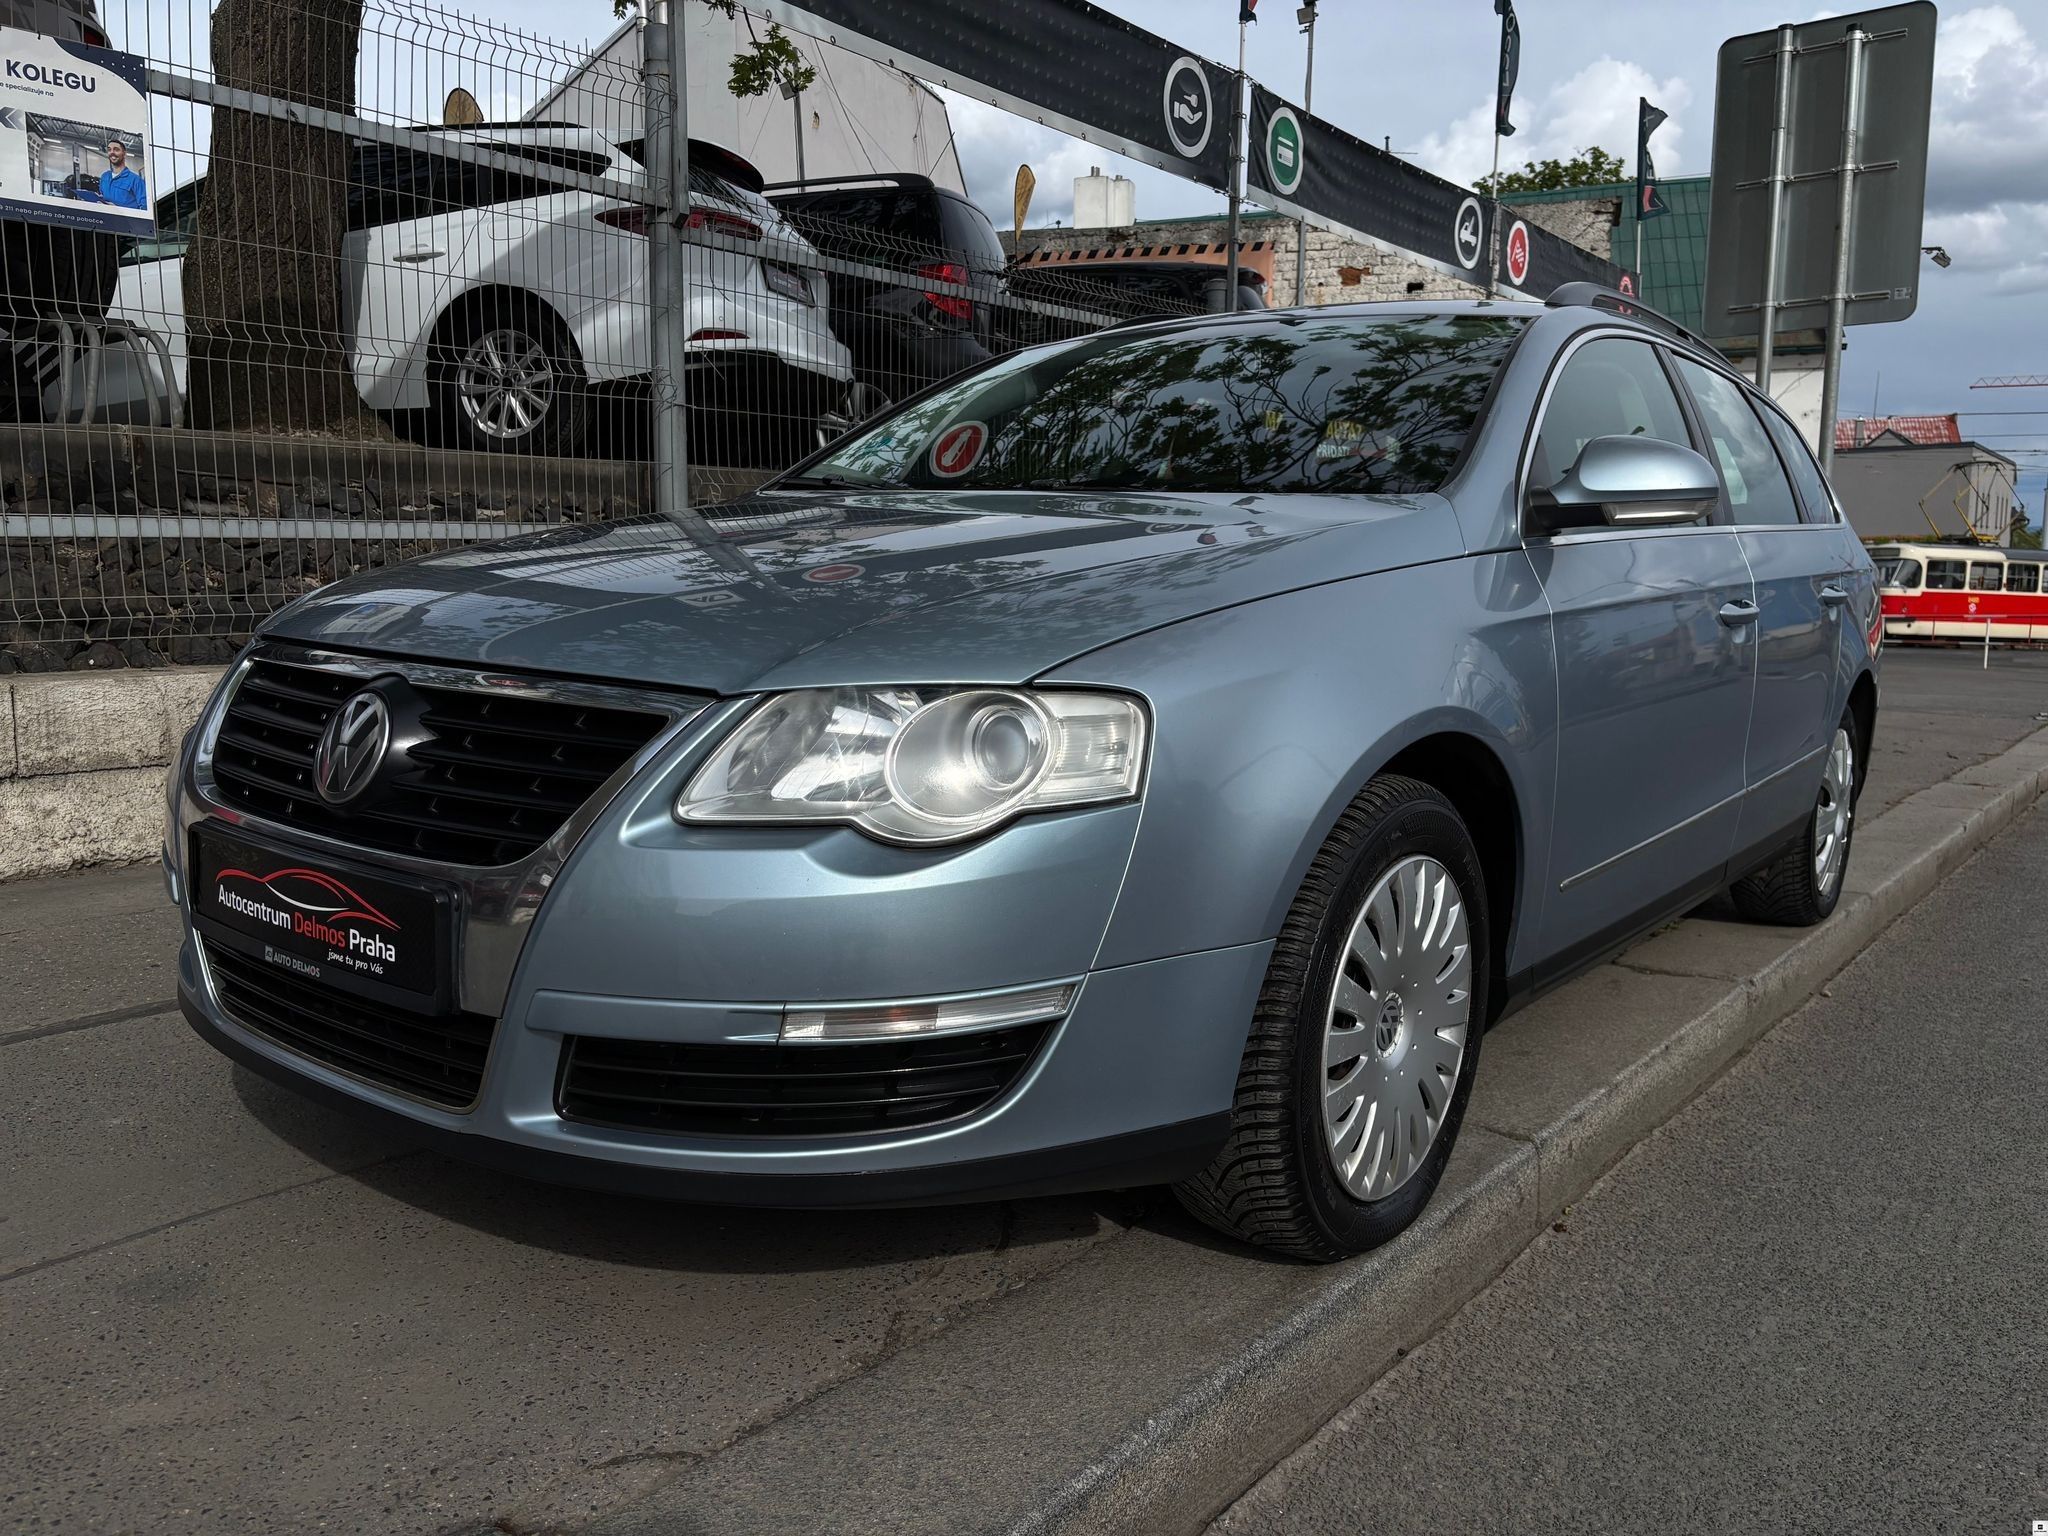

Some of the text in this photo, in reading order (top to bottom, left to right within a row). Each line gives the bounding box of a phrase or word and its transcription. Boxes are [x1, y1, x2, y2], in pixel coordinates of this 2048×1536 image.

[5, 82, 44, 96] specializuje
[6, 59, 96, 93] KOLEGU
[15, 205, 32, 215] nebo
[218, 884, 396, 962] Autocentrum Delmos Praha
[273, 952, 321, 978] AUTO DELMOS
[327, 949, 384, 975] jsme tu pro Vás
